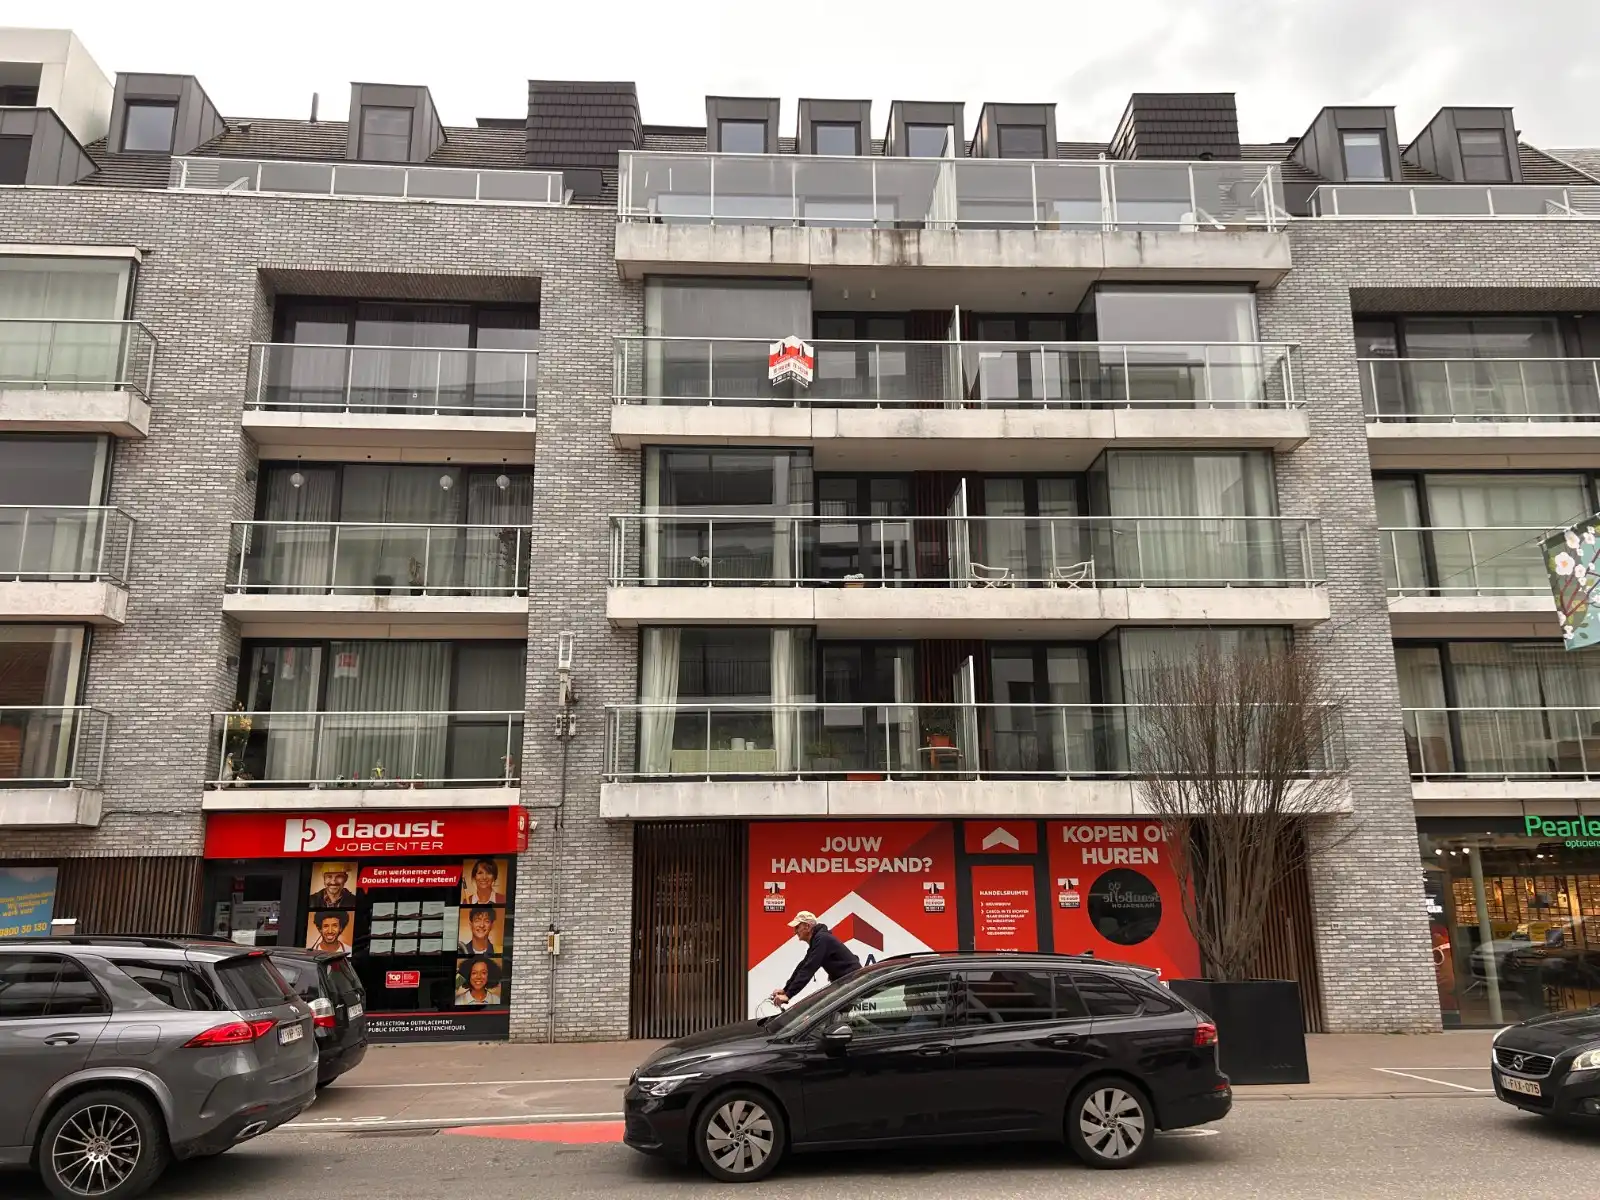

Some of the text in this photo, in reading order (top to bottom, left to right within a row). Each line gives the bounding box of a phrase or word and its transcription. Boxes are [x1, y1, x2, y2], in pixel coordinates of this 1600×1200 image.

[335, 818, 445, 839] daoust
[1062, 825, 1138, 843] KOPEN
[1524, 815, 1600, 837] Pearle
[335, 841, 444, 852] JOBCENTER
[820, 836, 883, 853] JOUW
[1081, 847, 1159, 865] HUREN
[373, 868, 388, 876] Een
[771, 857, 933, 874] HANDELSPAND?
[417, 876, 424, 884] je
